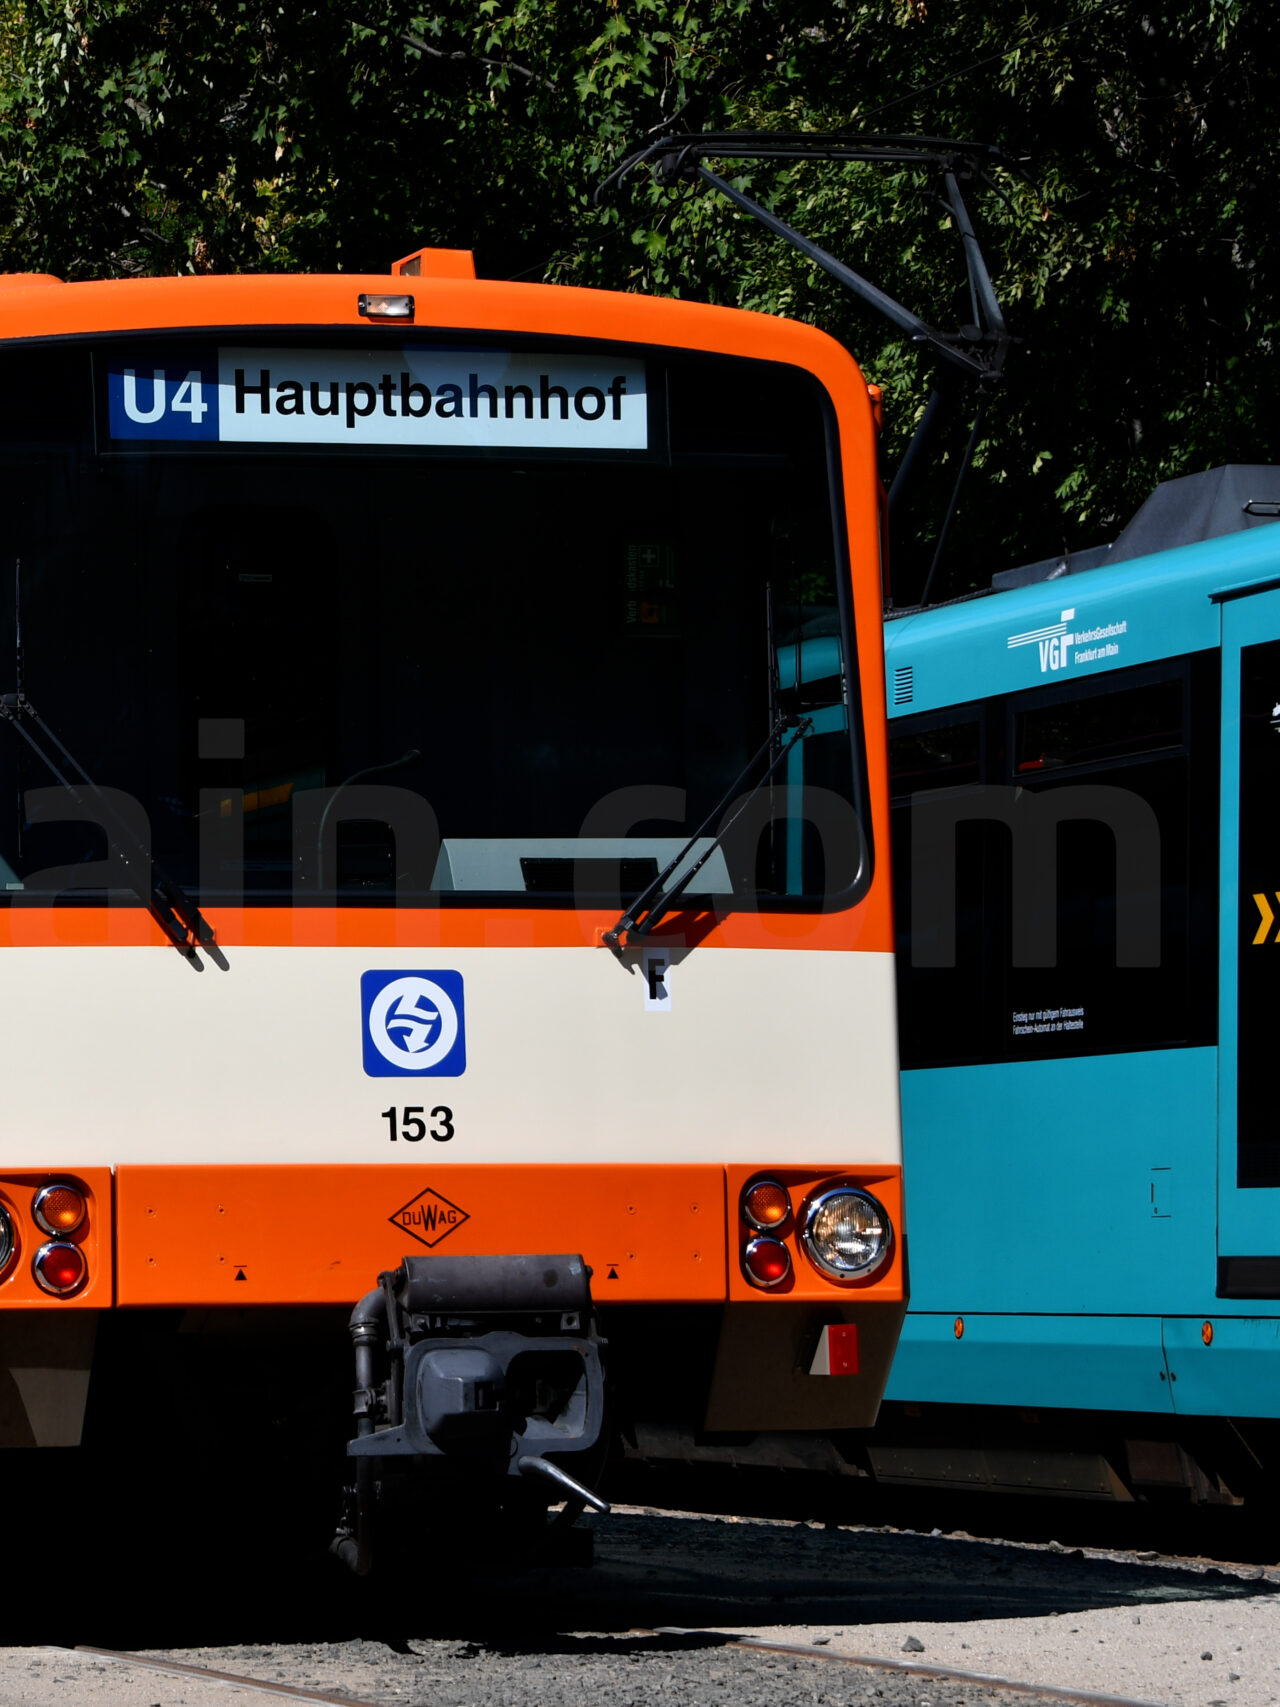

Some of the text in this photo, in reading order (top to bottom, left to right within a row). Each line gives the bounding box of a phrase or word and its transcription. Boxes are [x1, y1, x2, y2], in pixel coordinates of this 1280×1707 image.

[123, 368, 628, 429] U4 Hauptbahnhof
[1074, 647, 1098, 664] Frankfurt
[1105, 642, 1119, 657] Main
[648, 958, 665, 1000] F
[381, 1105, 455, 1142] 153
